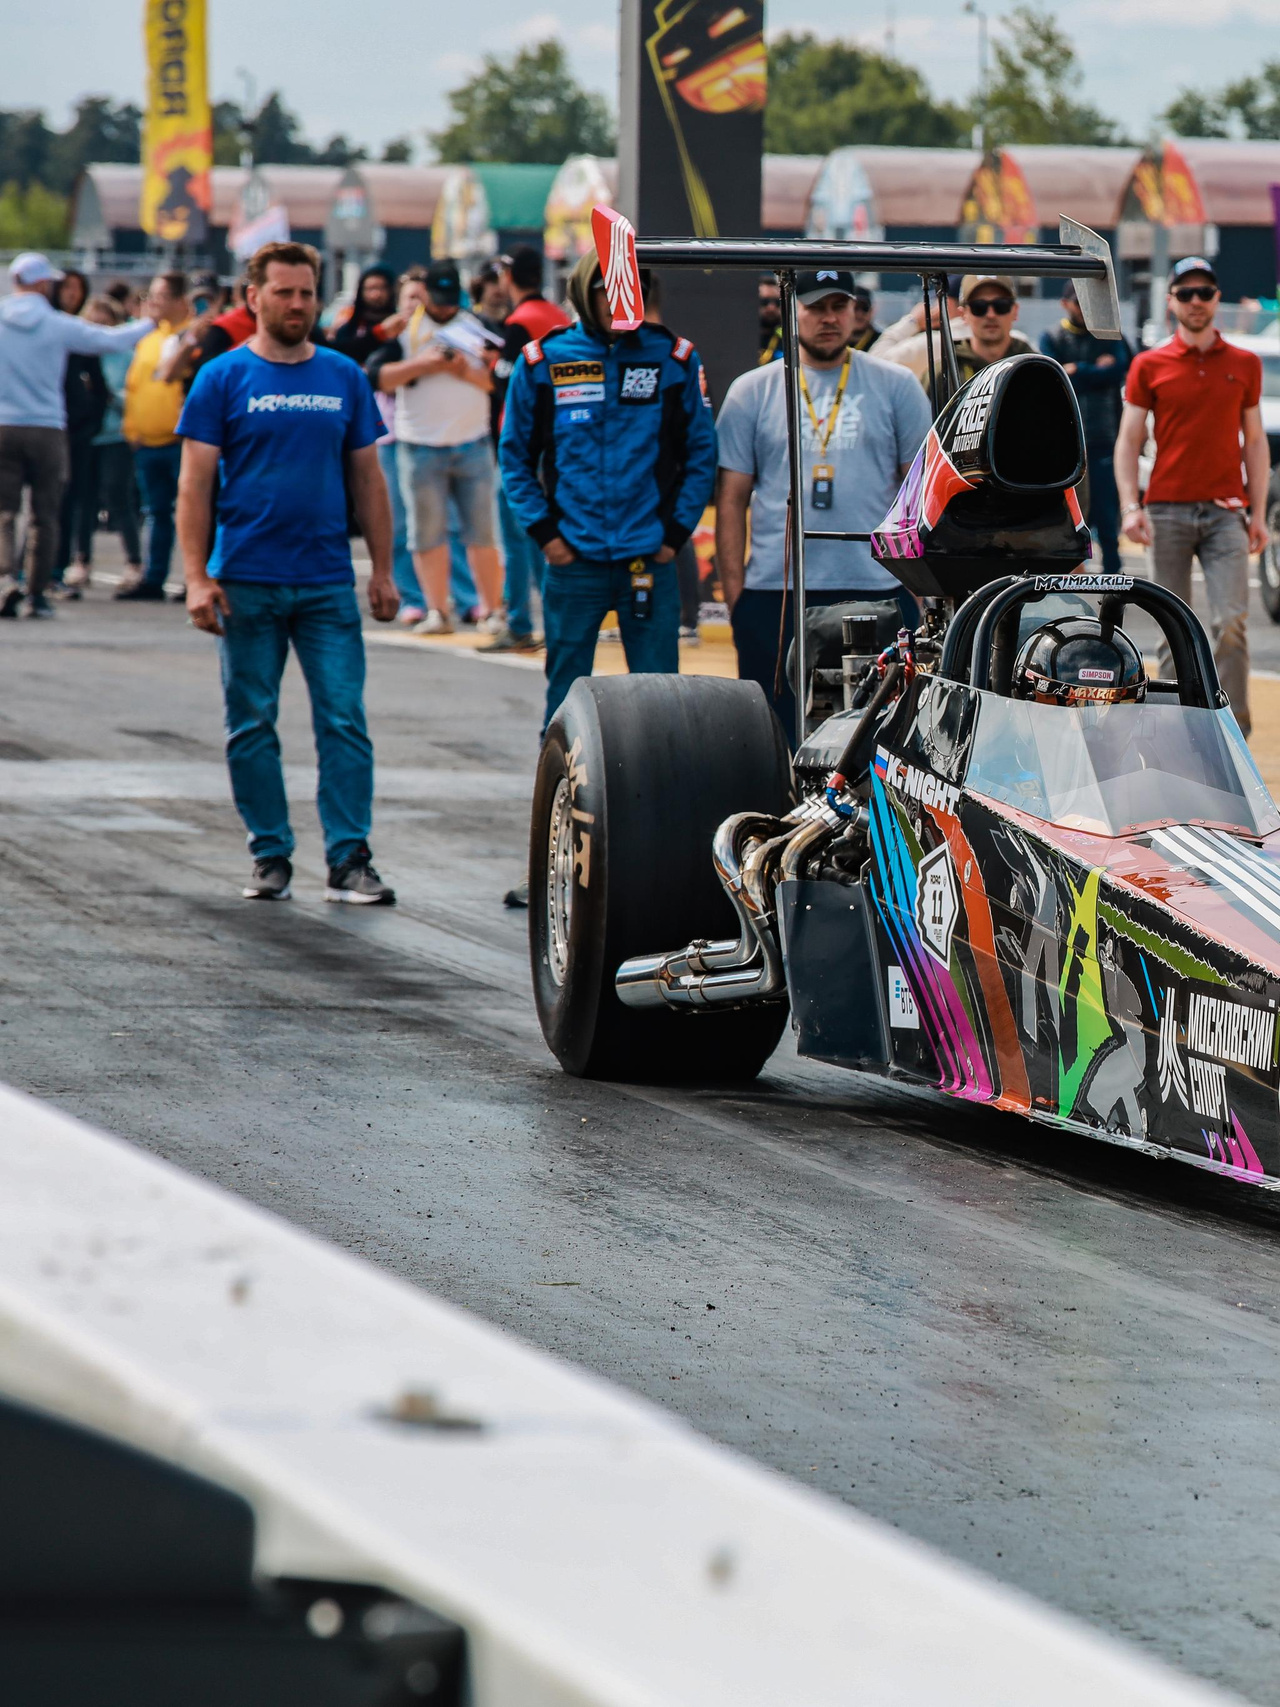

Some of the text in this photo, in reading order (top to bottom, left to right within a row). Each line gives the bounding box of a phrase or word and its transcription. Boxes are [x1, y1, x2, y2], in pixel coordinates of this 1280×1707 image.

[1081, 669, 1112, 680] SIMPSON
[931, 889, 943, 925] 11
[1187, 992, 1276, 1072] МОСКОВСКИЙ
[1188, 1056, 1230, 1123] СПОРТ
